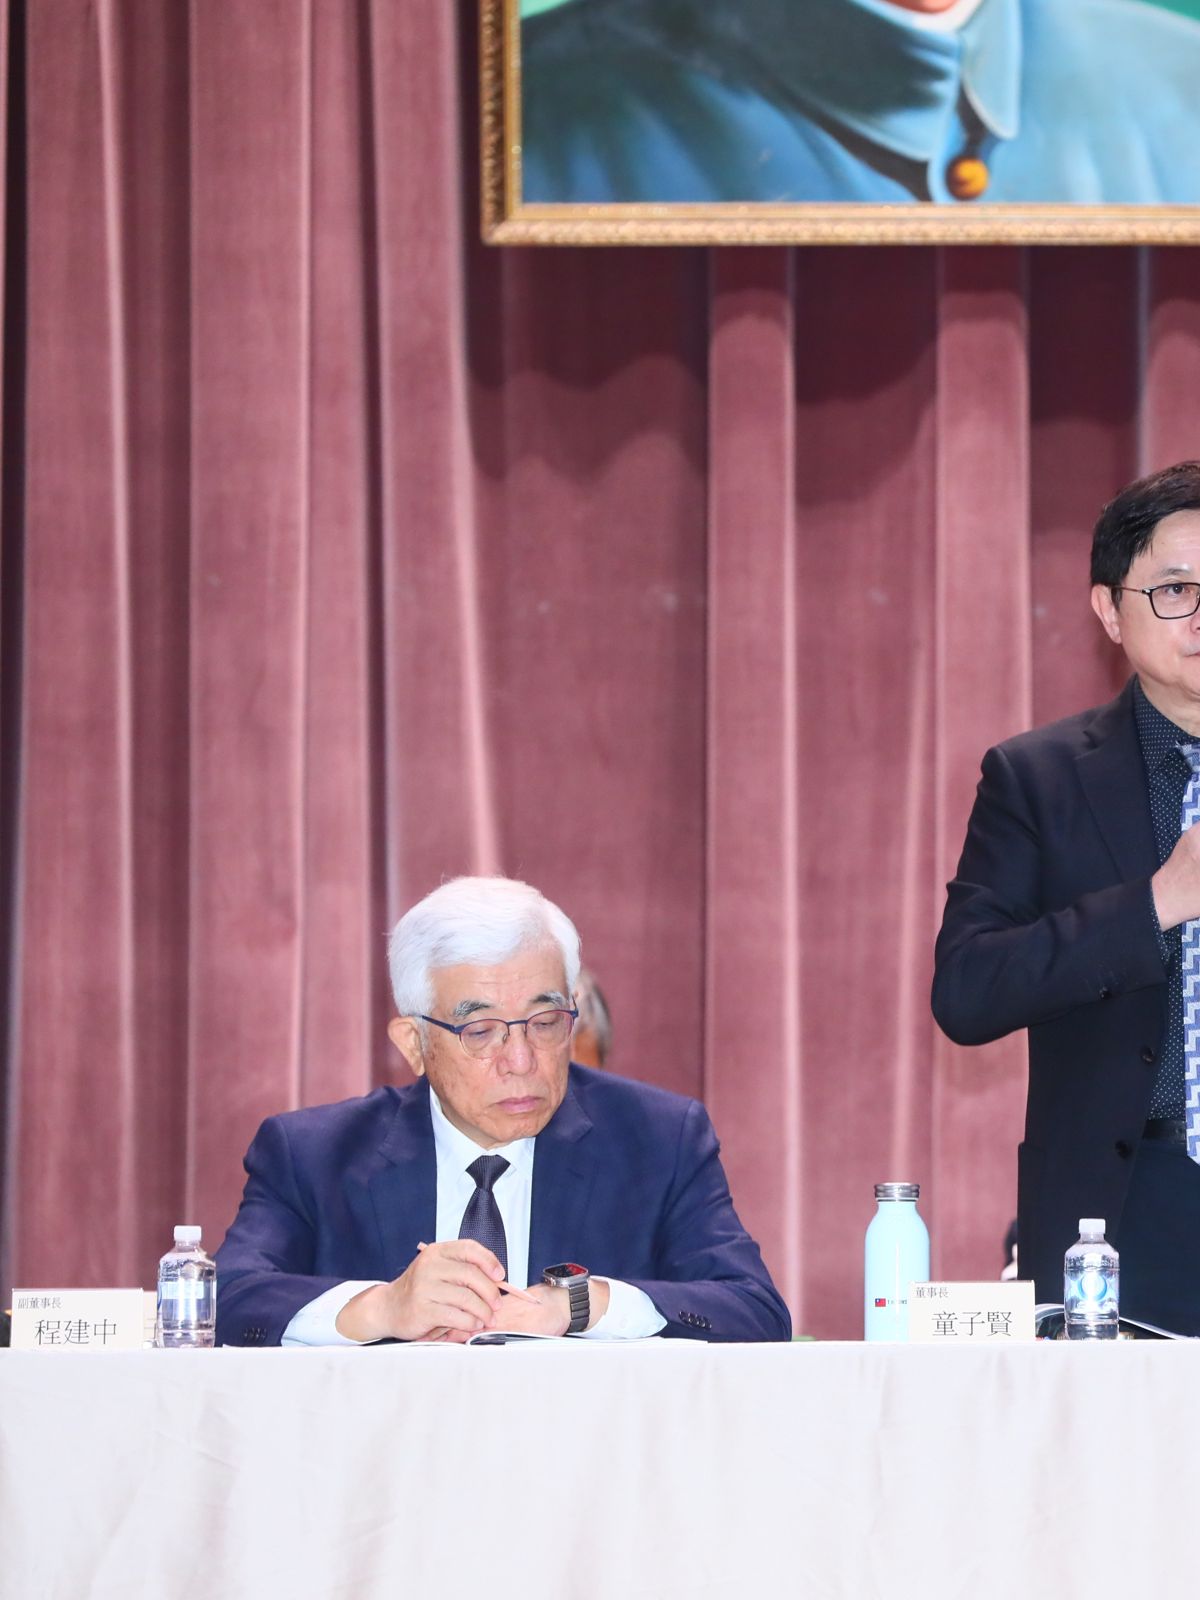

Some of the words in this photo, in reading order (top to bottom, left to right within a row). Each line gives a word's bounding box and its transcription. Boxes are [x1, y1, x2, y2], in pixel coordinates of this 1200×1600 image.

[916, 1286, 949, 1299] 董事長
[17, 1296, 62, 1309] 副董事長
[34, 1318, 117, 1345] 程建中
[931, 1311, 1013, 1336] 童子賢
